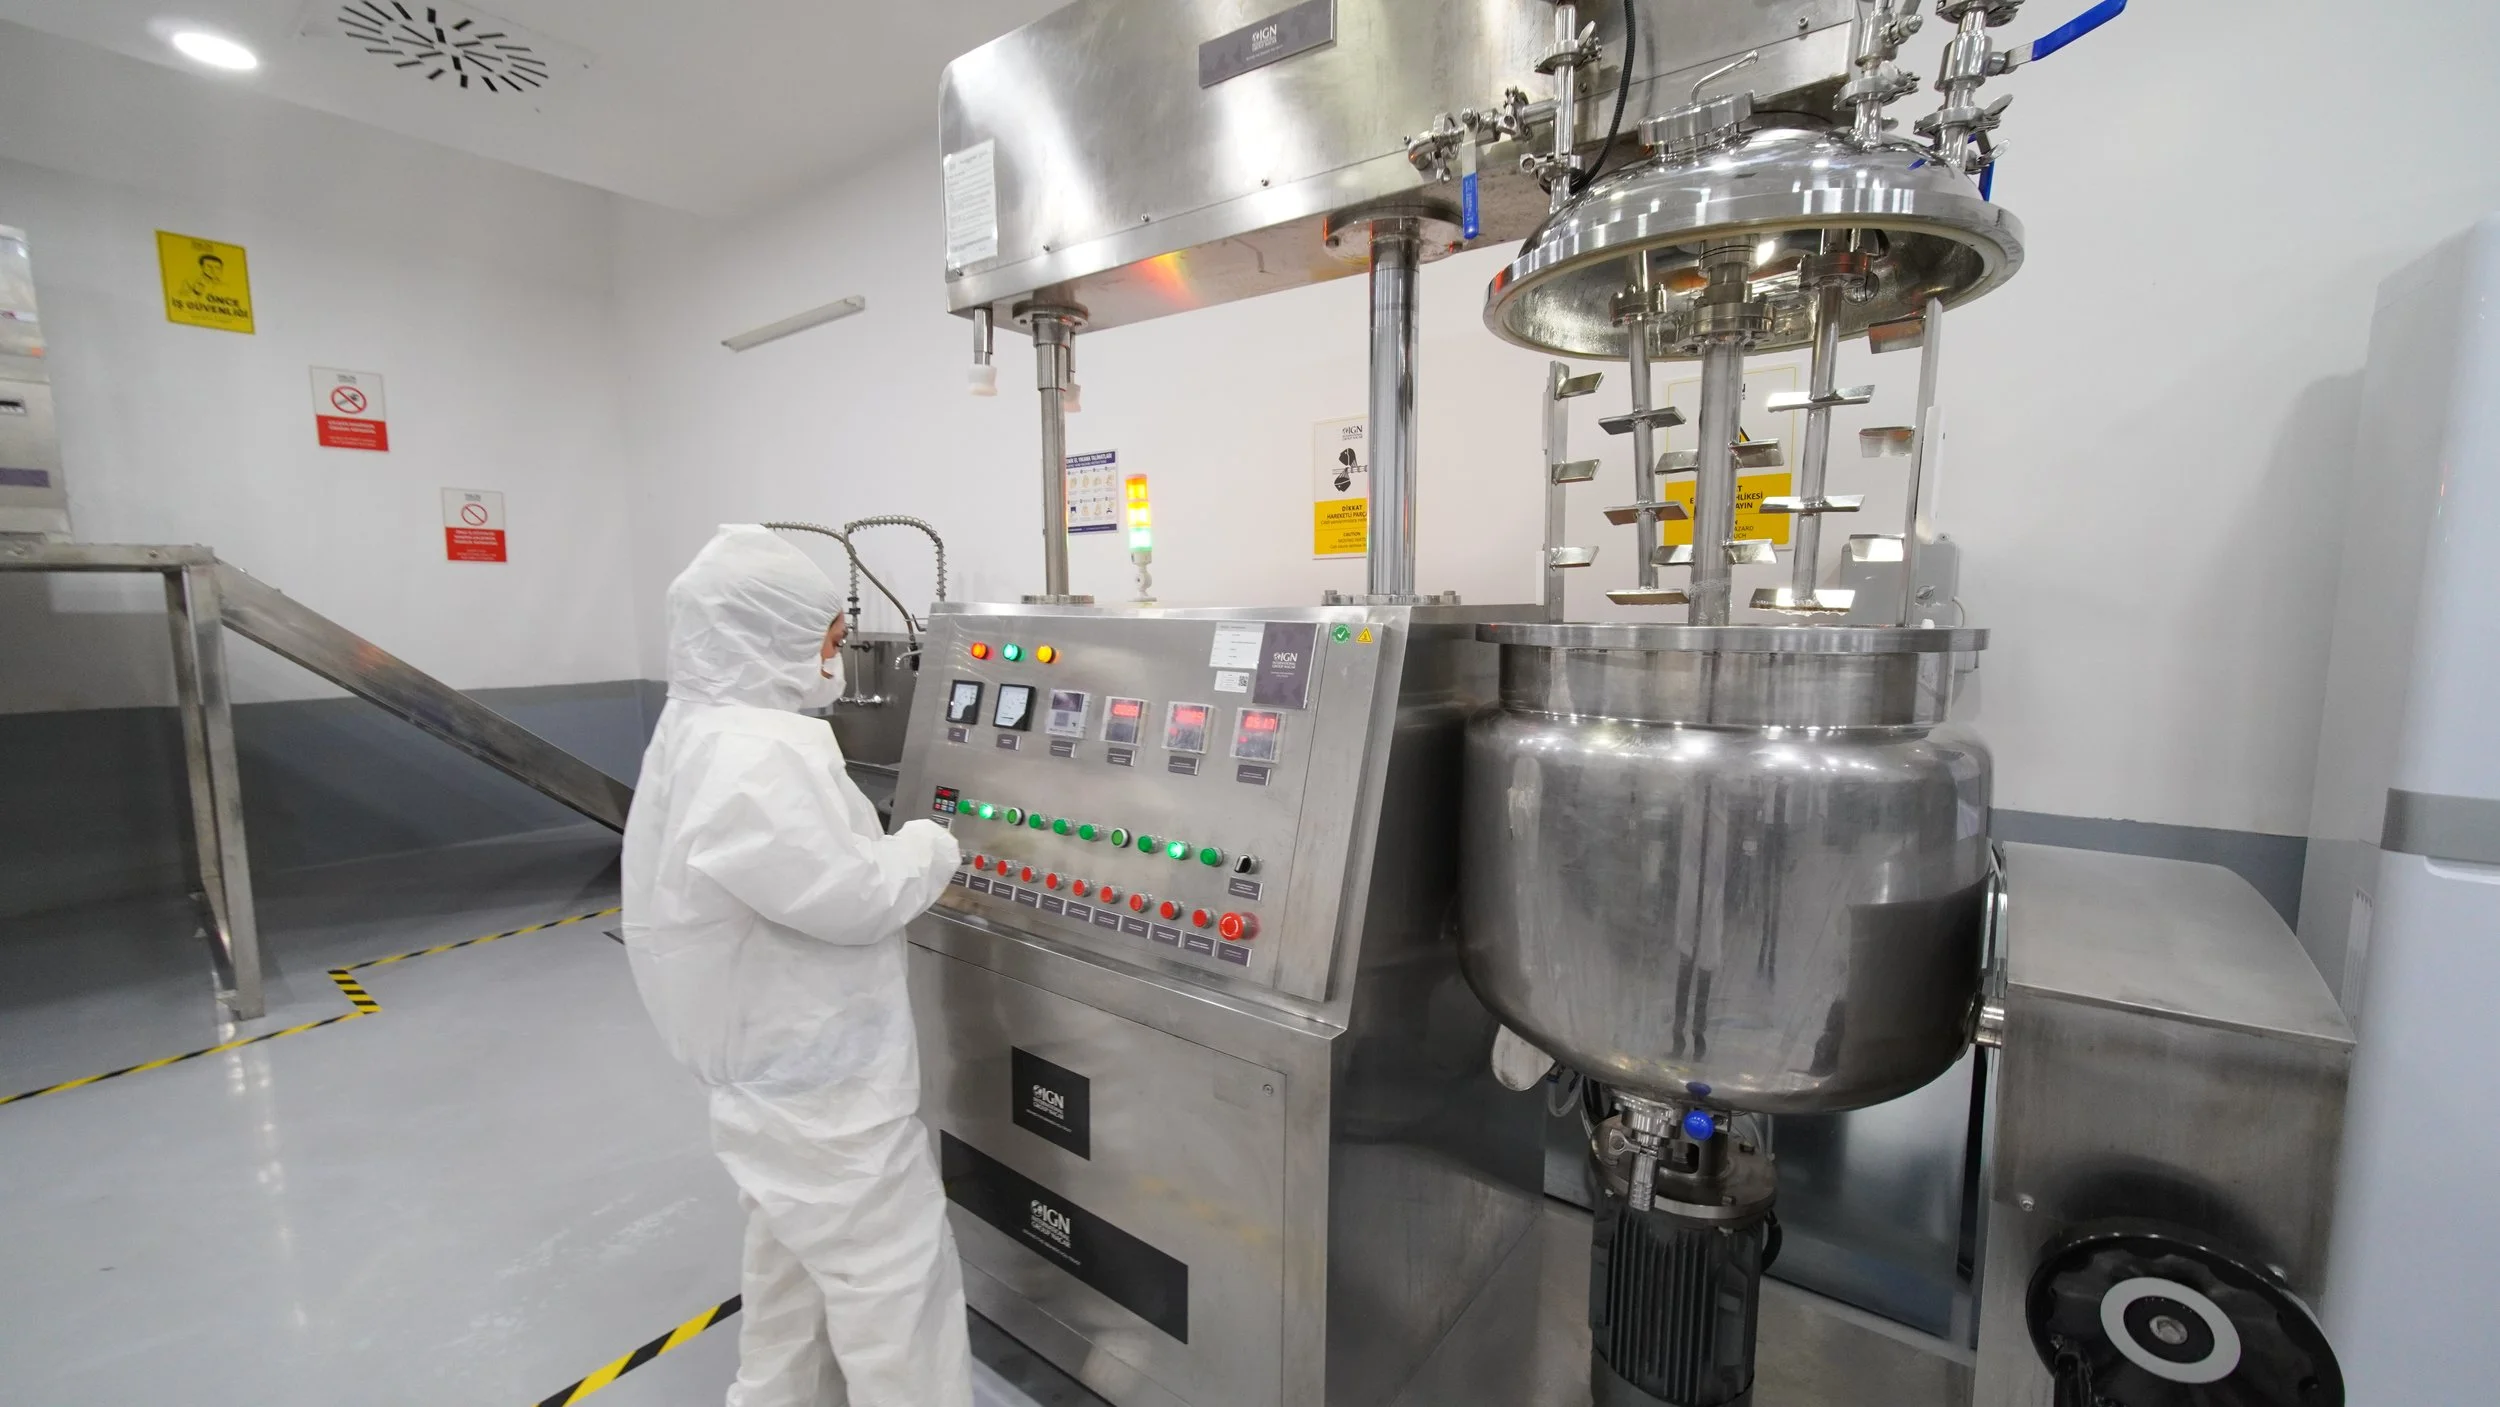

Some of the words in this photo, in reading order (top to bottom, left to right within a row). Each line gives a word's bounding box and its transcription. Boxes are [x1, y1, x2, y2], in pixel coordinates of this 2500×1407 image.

[1260, 24, 1277, 41] IGN
[1348, 425, 1363, 434] IGN
[1281, 652, 1298, 662] IGN
[1042, 1088, 1064, 1109] IGN
[1042, 1204, 1071, 1235] IGN
